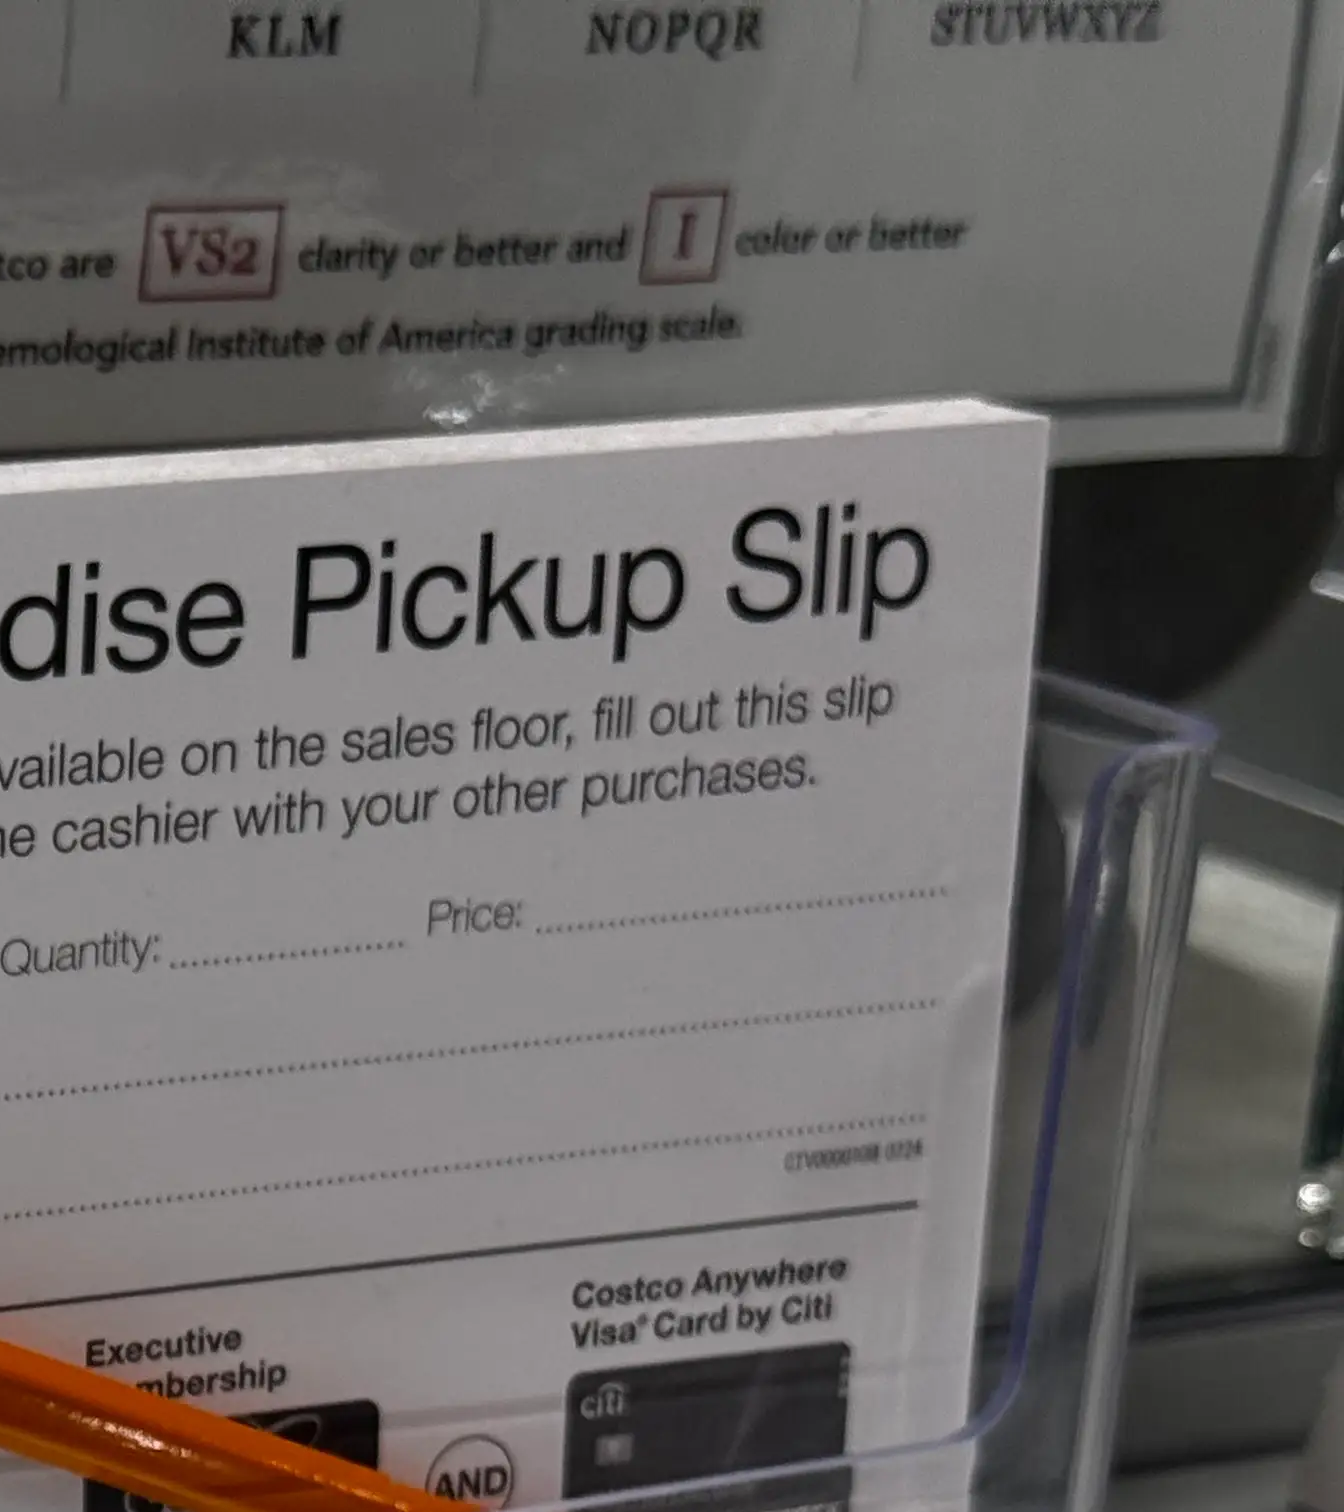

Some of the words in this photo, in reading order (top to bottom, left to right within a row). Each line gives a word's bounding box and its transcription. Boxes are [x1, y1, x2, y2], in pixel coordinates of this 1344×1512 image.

[227, 8, 340, 60] KLM
[585, 7, 764, 60] NOPQR
[58, 250, 119, 283] are
[164, 226, 259, 277] VS2
[298, 236, 401, 280] clarity
[409, 240, 447, 269] or
[453, 230, 560, 268] better
[566, 223, 634, 264] and
[735, 218, 819, 257] color
[825, 224, 862, 253] or
[868, 214, 970, 251] better
[187, 326, 328, 361] Institute
[335, 316, 375, 356] of
[377, 317, 519, 355] America
[522, 310, 654, 357] grading
[292, 531, 686, 664] Pickup
[726, 501, 932, 641] Slip
[181, 740, 237, 776] on
[254, 725, 326, 770] the
[341, 715, 456, 763] sales
[472, 706, 574, 751] floor,
[593, 695, 636, 741] fill
[650, 691, 720, 736] out
[736, 681, 811, 728] this
[824, 675, 895, 726] slip
[52, 801, 220, 854] cashier
[233, 789, 326, 838] with
[342, 786, 440, 839] your
[453, 772, 569, 819] other
[581, 754, 816, 818] purchases.
[427, 897, 522, 937] Price:
[0, 930, 160, 977] Quantity:
[572, 1277, 683, 1310] Costco
[691, 1257, 848, 1297] Anywhere
[653, 1306, 728, 1340] Card
[736, 1301, 772, 1333] by
[781, 1292, 833, 1323] Citi
[85, 1327, 243, 1367] Executive
[135, 1359, 287, 1400] mbership
[434, 1465, 509, 1501] AND
